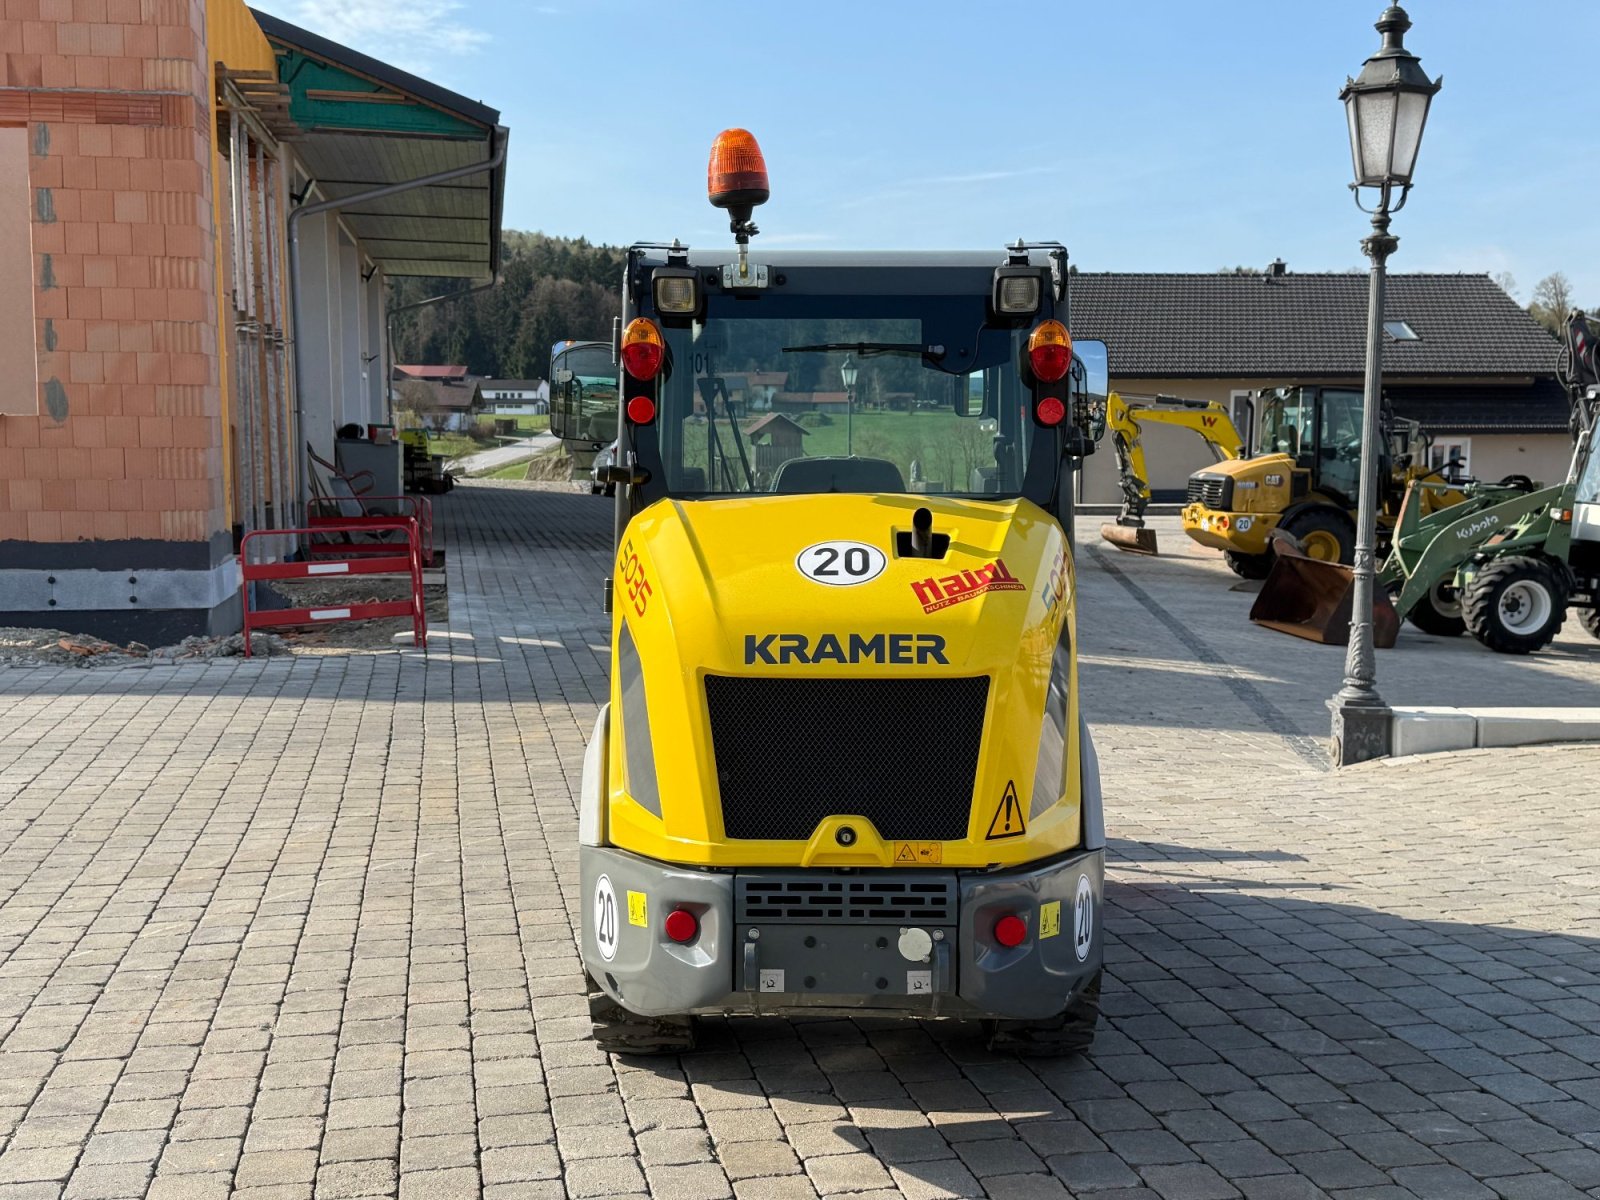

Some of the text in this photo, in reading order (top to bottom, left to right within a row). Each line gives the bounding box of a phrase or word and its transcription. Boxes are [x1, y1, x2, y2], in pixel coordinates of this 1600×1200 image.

[1265, 474, 1281, 486] CAT
[1238, 519, 1249, 530] 20
[1456, 515, 1499, 539] Kubota
[813, 547, 870, 576] 20
[619, 538, 653, 618] 5035
[926, 600, 951, 613] NUTZ
[957, 583, 1025, 602] BAUMASCHINEN
[744, 633, 950, 665] KRAMER
[598, 889, 615, 947] 20
[1078, 889, 1092, 947] 20
